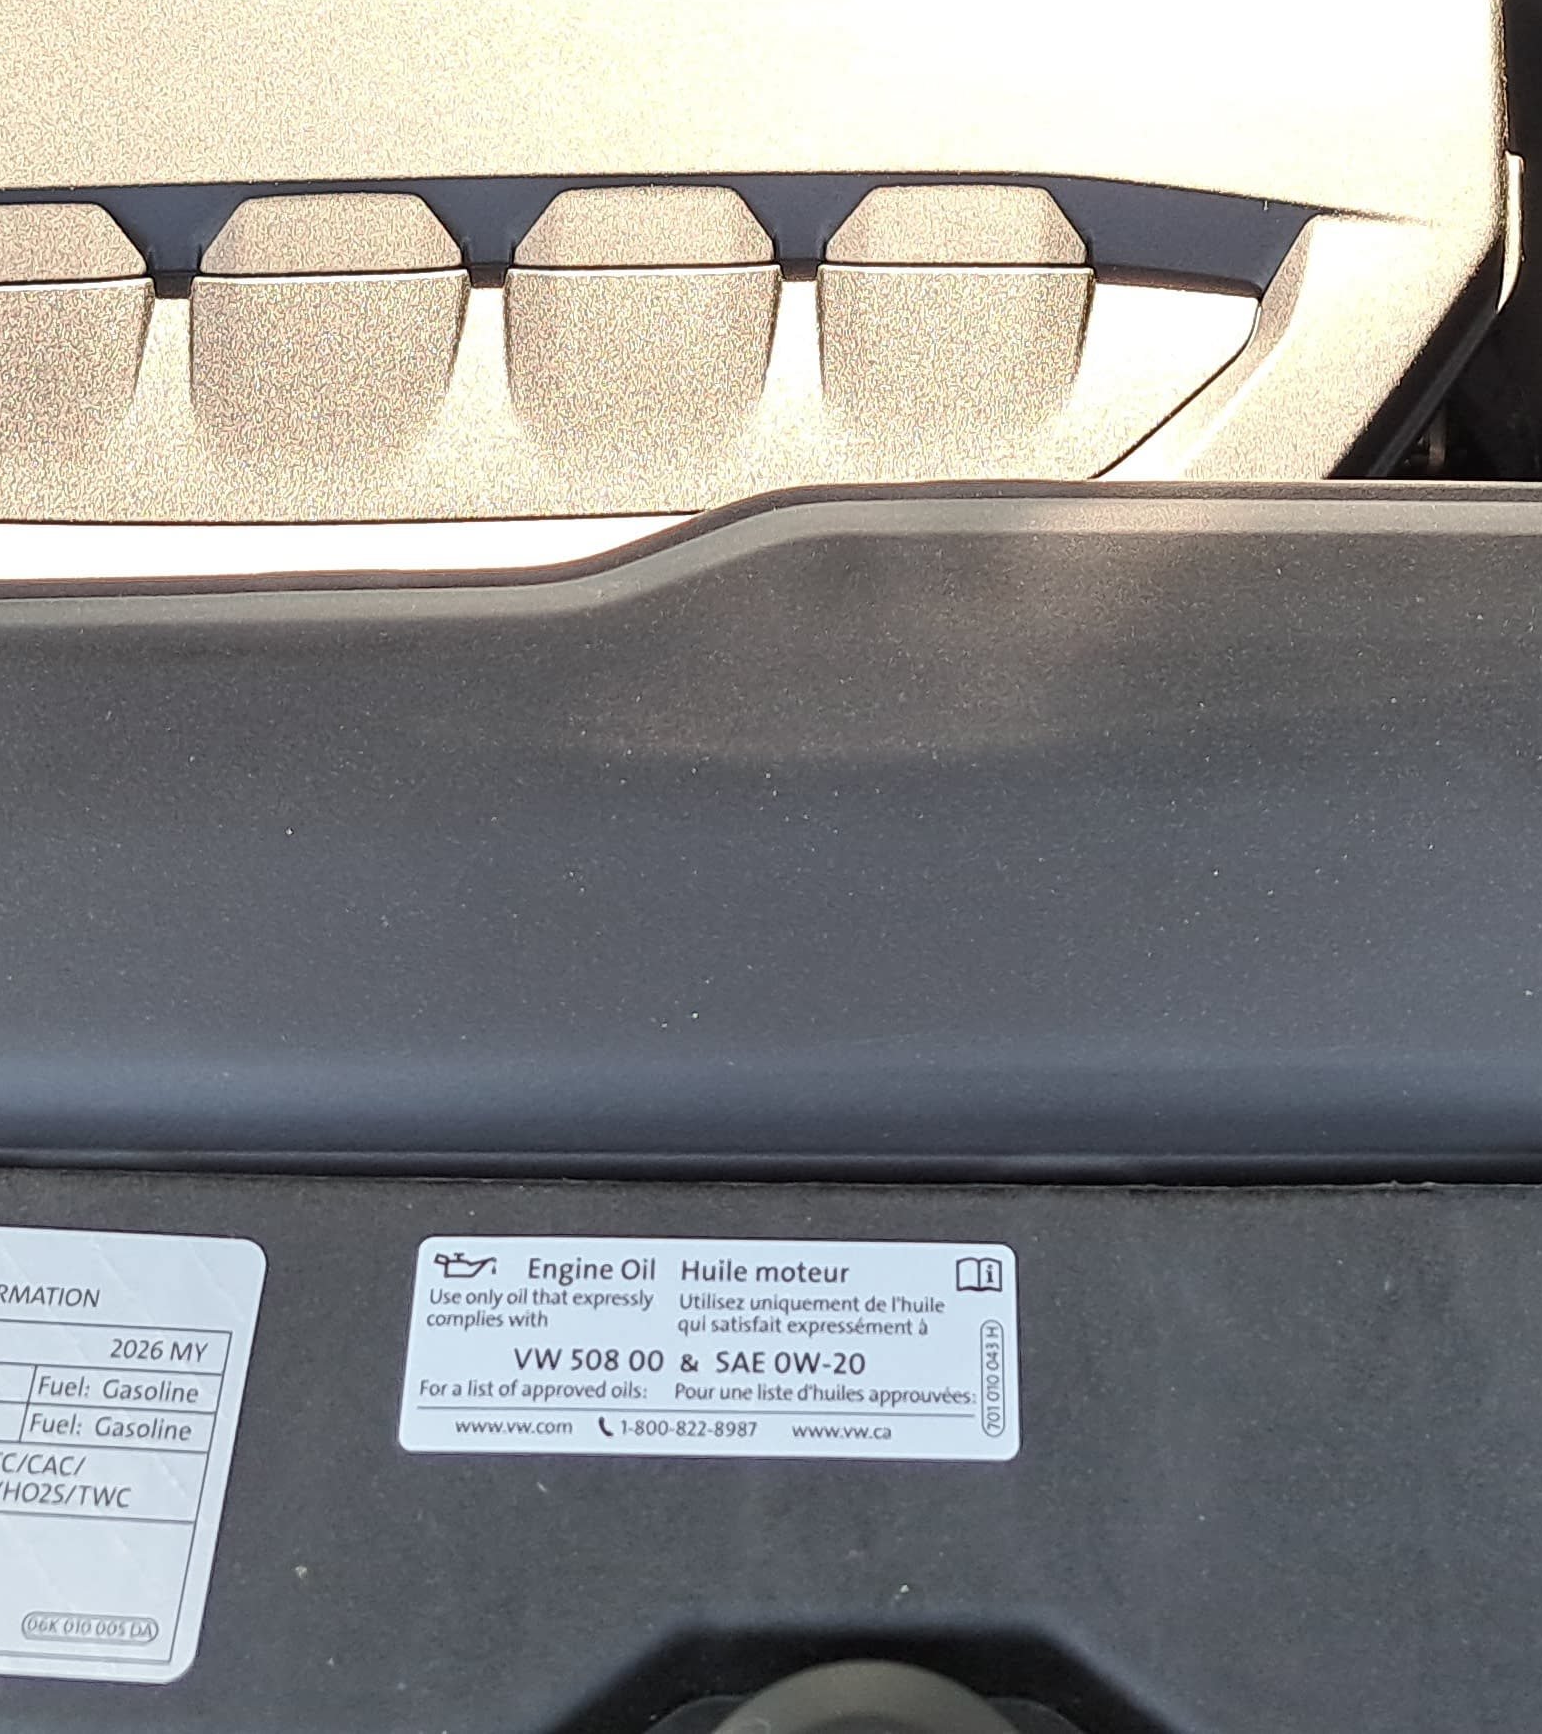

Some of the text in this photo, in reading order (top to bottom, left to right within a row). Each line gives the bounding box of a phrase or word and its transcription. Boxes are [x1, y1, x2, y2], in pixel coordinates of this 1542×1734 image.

[527, 1256, 656, 1287] Engine Oil
[680, 1258, 850, 1283] Huile moteur
[428, 1287, 654, 1312] Use only oil that expressly
[678, 1292, 946, 1316] Utilisez uniquement de l'huile
[425, 1309, 548, 1331] complies with
[676, 1314, 706, 1337] qui
[710, 1314, 782, 1334] satisfait
[785, 1316, 913, 1338] expressément
[985, 1325, 999, 1339] H
[109, 1337, 209, 1363] 2026 MY
[513, 1347, 866, 1375] VW 508 00 & SAE 0W-20
[36, 1374, 90, 1397] Fuel:
[101, 1378, 199, 1404] Gasoline
[418, 1377, 647, 1402] For a list of approved oils:
[673, 1381, 976, 1408] Pour une liste d'huiles approuvées:
[985, 1374, 1000, 1402] 010
[28, 1411, 82, 1435] Fuel:
[94, 1415, 192, 1442] Gasoline
[454, 1420, 573, 1435] www.vw.com
[620, 1418, 758, 1438] 1-800-822-8987
[986, 1405, 1000, 1430] 701
[791, 1424, 892, 1440] www.vw.ca
